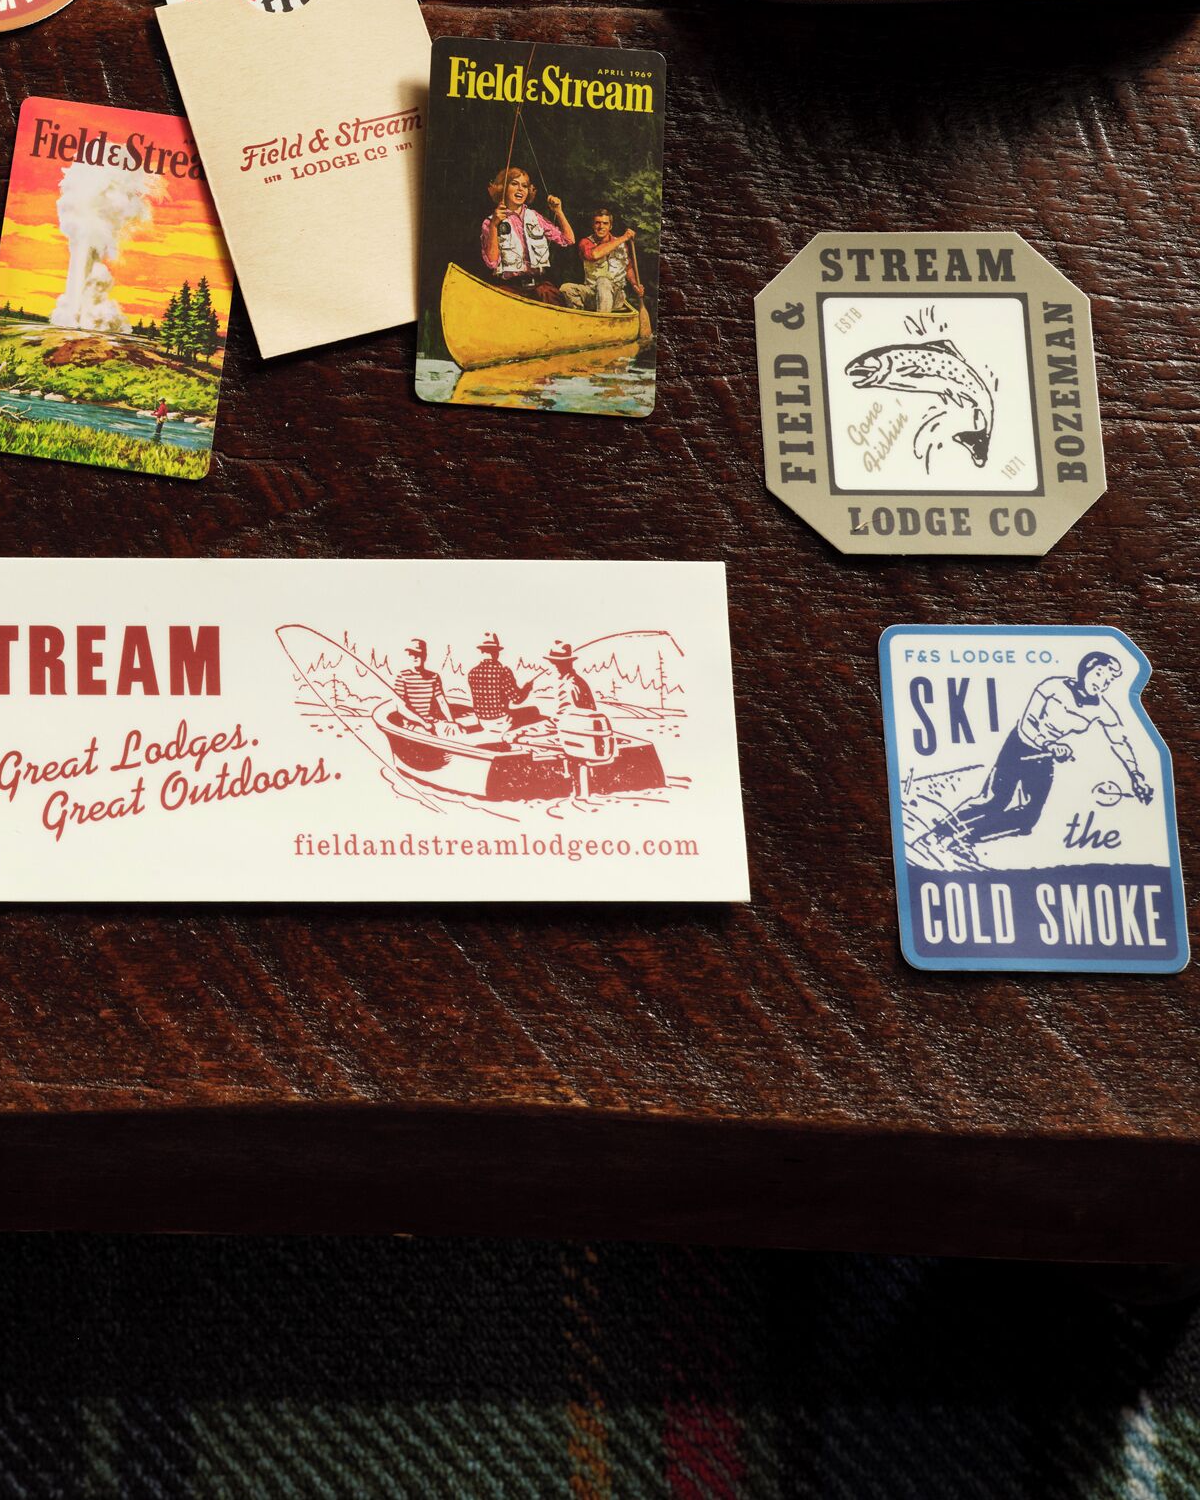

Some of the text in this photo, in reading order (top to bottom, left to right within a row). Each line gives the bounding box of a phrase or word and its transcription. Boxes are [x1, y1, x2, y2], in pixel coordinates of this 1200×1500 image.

[446, 56, 654, 114] Field Stream
[597, 68, 653, 80] APRIL 1969
[29, 117, 108, 167] Field
[240, 106, 425, 172] Field & Stream
[395, 141, 414, 153] 1871
[263, 174, 283, 185] ESTB
[289, 152, 361, 181] LODGE
[819, 248, 1017, 283] STREAM
[833, 306, 863, 335] ESTB
[770, 301, 818, 485] FIELD &
[1042, 301, 1088, 484] BOZEMAN
[846, 400, 884, 448] Gone
[1000, 456, 1027, 480] 1871
[847, 506, 1038, 537] LODGE CO
[904, 650, 1060, 664] F&S LODGE CO.
[909, 676, 1000, 757] SKI
[110, 719, 260, 772] Lodges.
[42, 757, 343, 842] Great Outdoors.
[293, 832, 700, 862] fieldandstreamlodgeco.com
[1063, 811, 1123, 850] the
[920, 882, 1168, 947] COLD SMOKE
